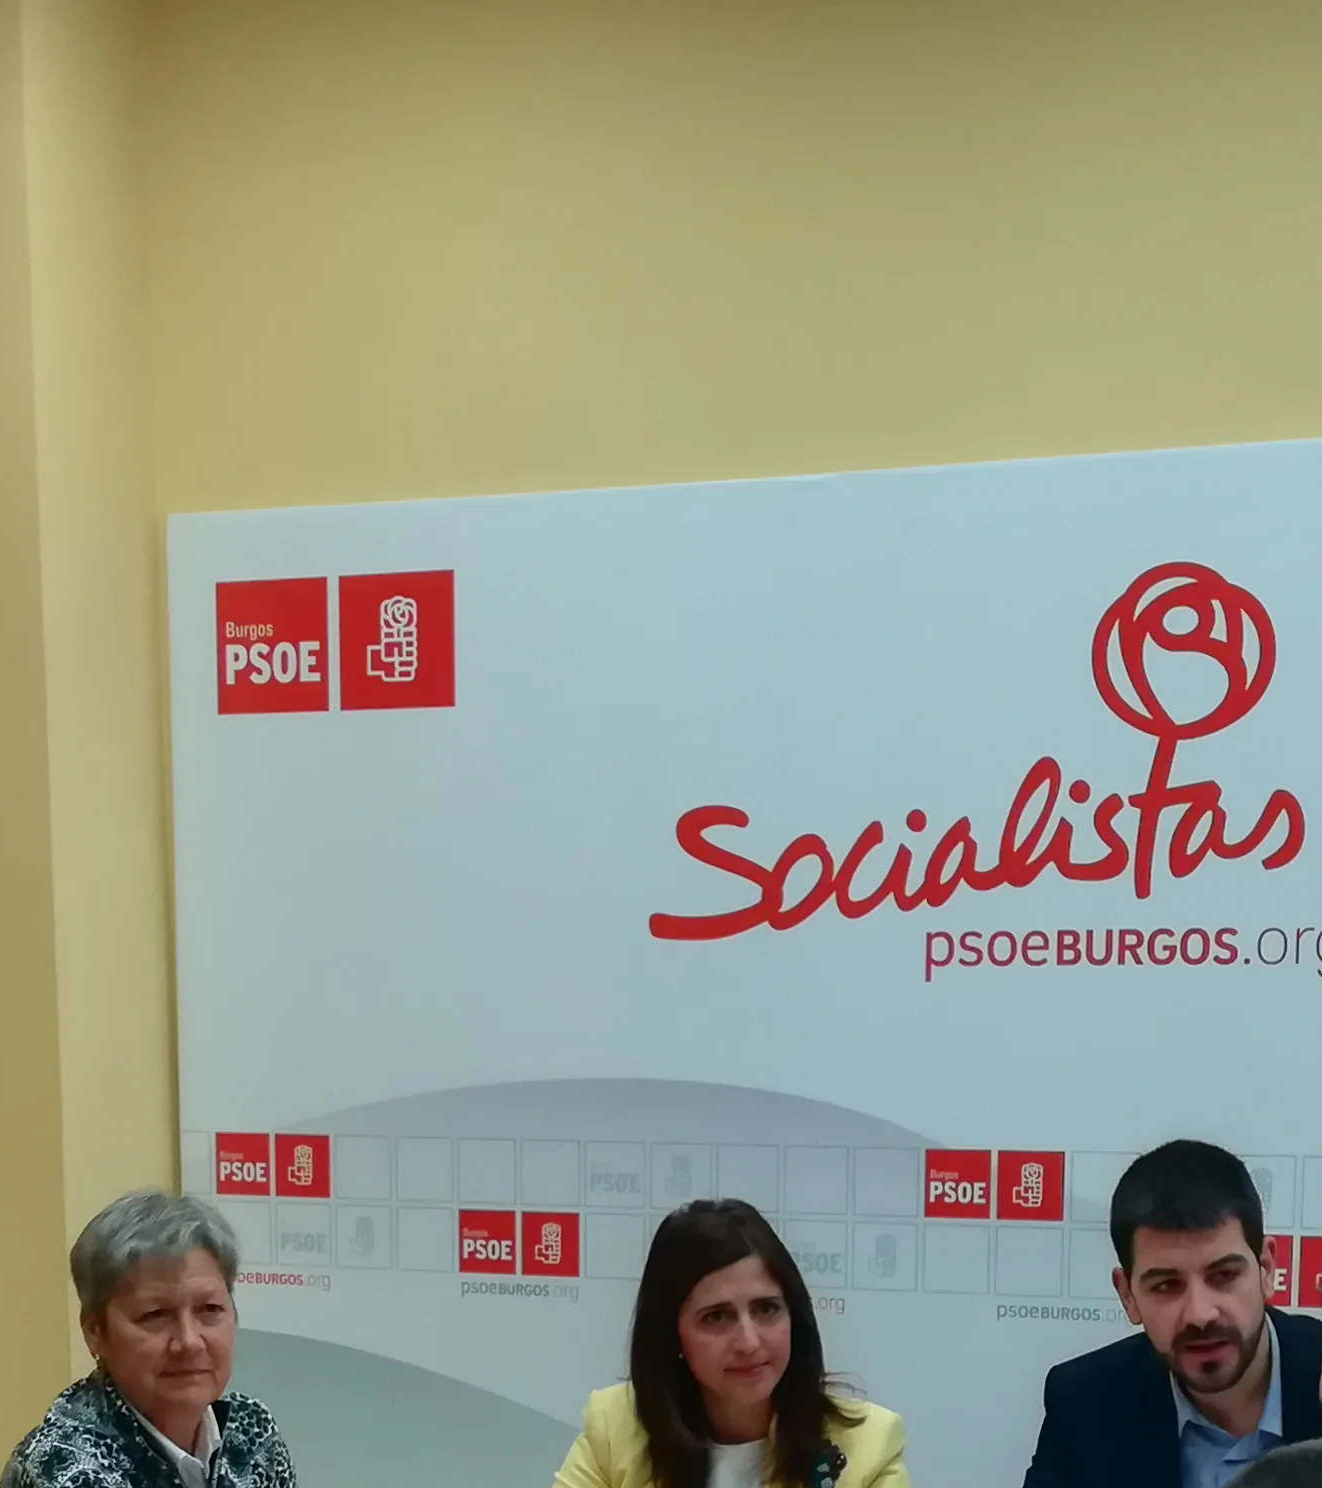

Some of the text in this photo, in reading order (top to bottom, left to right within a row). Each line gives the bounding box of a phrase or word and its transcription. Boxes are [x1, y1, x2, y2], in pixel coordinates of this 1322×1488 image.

[226, 621, 274, 641] Burgos
[225, 640, 322, 686] PSOE
[648, 740, 1306, 942] Socialistas
[219, 1161, 268, 1183] PSOE
[929, 1180, 987, 1205] PSOE
[462, 1238, 513, 1261] PSOE
[996, 1304, 1127, 1324] psoeBURGOS.or
